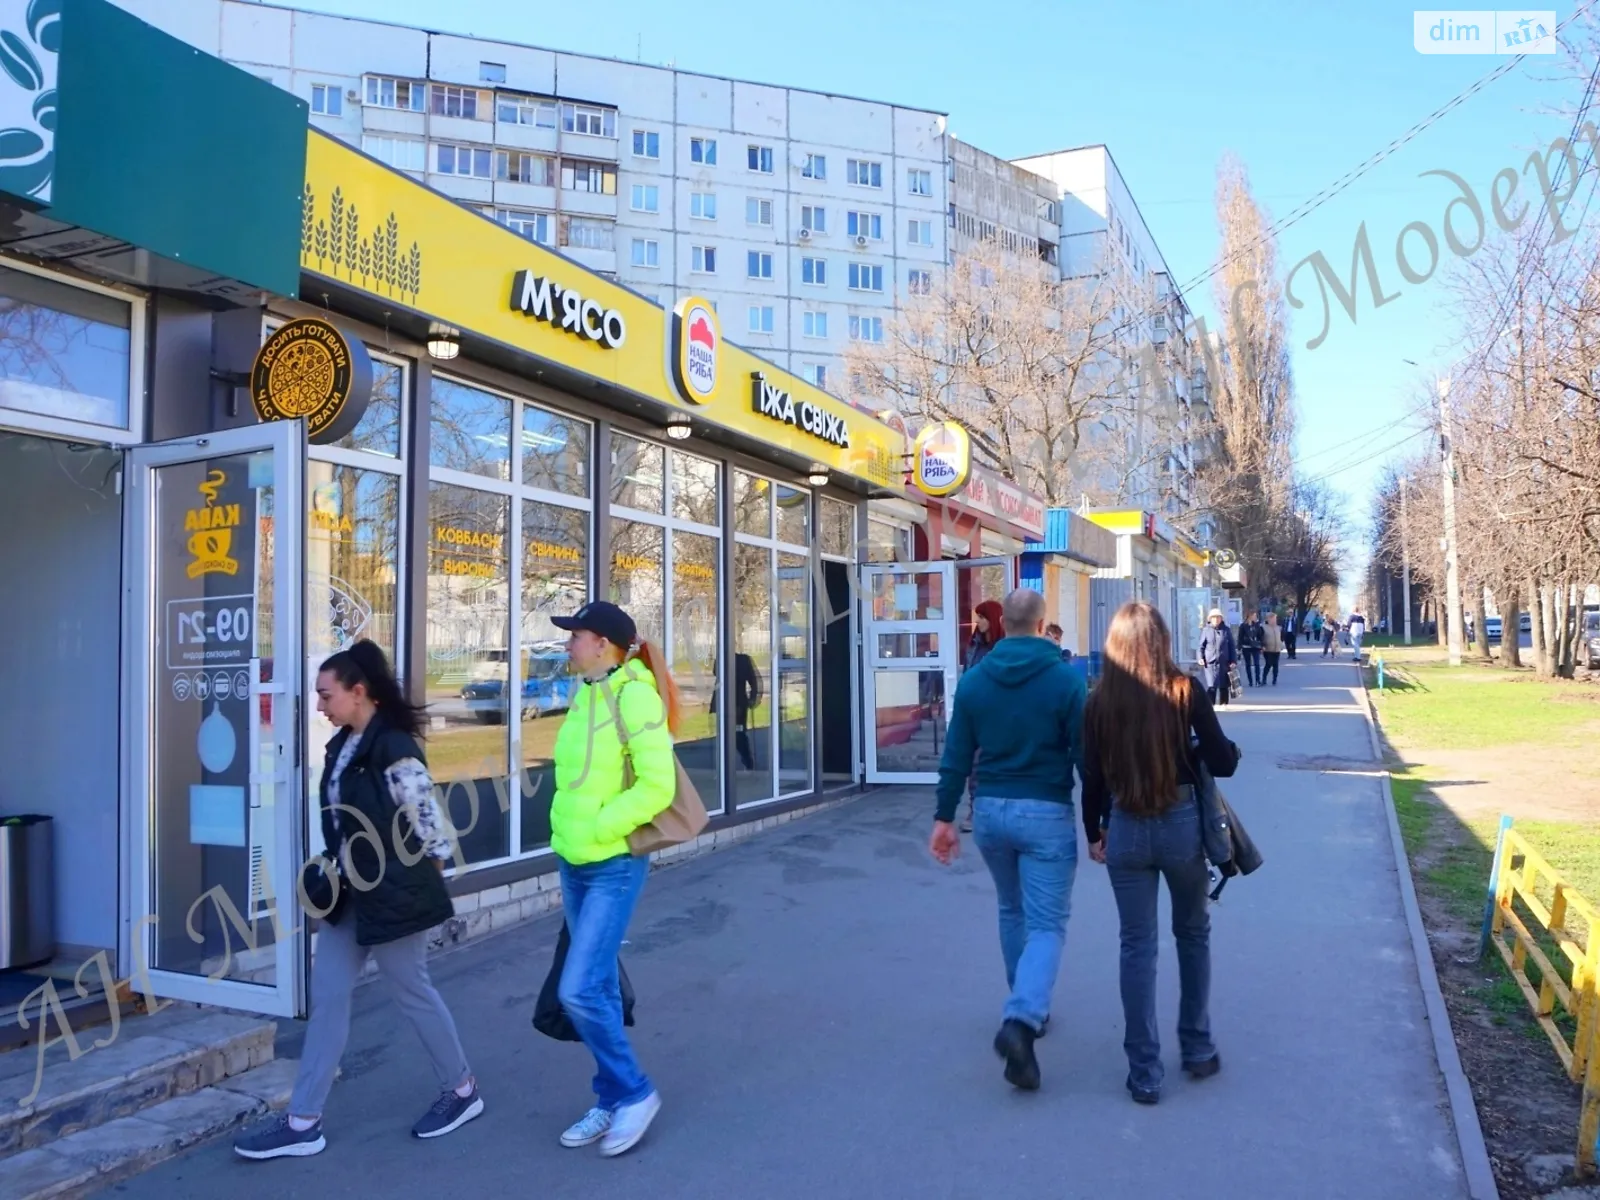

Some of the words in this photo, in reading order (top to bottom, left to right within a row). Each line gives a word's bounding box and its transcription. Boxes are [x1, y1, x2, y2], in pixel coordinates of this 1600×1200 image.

[512, 269, 626, 350] М'ЯСО
[261, 328, 301, 368] ДОСИТЬ
[303, 324, 347, 368] ГОТУВАТИ
[689, 346, 713, 365] НАША
[689, 359, 713, 382] РЯБА
[258, 388, 273, 418] ЧАС
[754, 371, 797, 426] ЇЖА
[799, 401, 850, 449] СВІЖА
[924, 465, 955, 478] РЯБА
[925, 457, 955, 467] НАШ
[529, 541, 581, 561] СВИНИНА
[443, 559, 496, 579] ВИРОБИ
